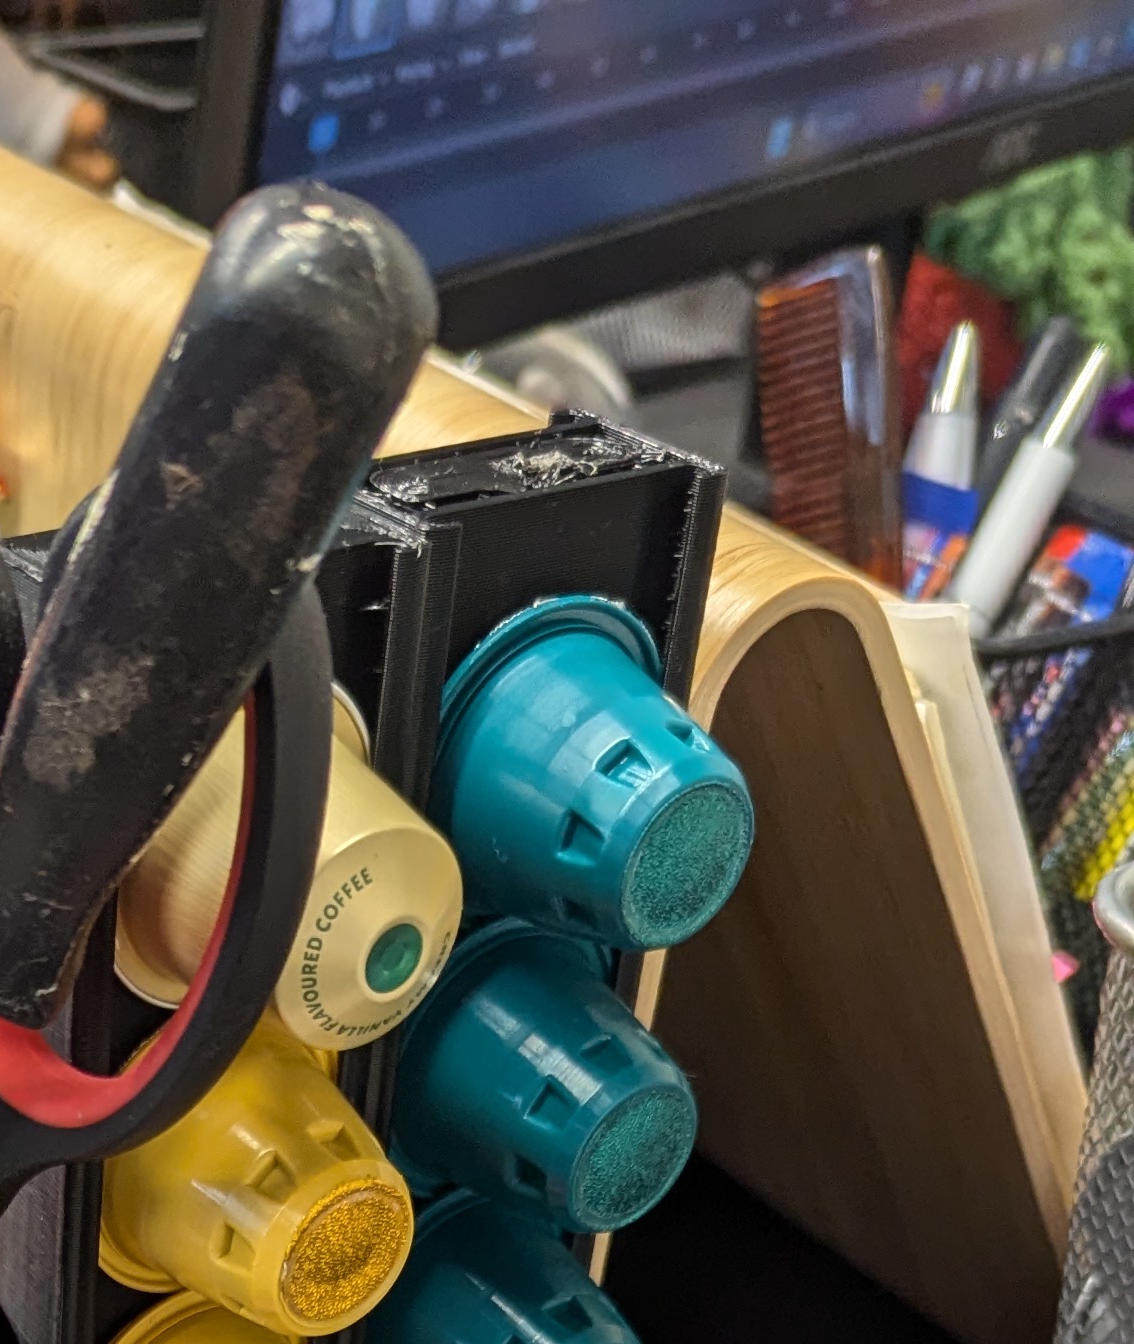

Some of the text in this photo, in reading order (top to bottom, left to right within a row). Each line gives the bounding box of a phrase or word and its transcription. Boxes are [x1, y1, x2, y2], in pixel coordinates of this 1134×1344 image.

[316, 866, 374, 933] COFFEE
[301, 937, 339, 1032] FLAVOURED
[336, 1009, 403, 1037] VANILLA
